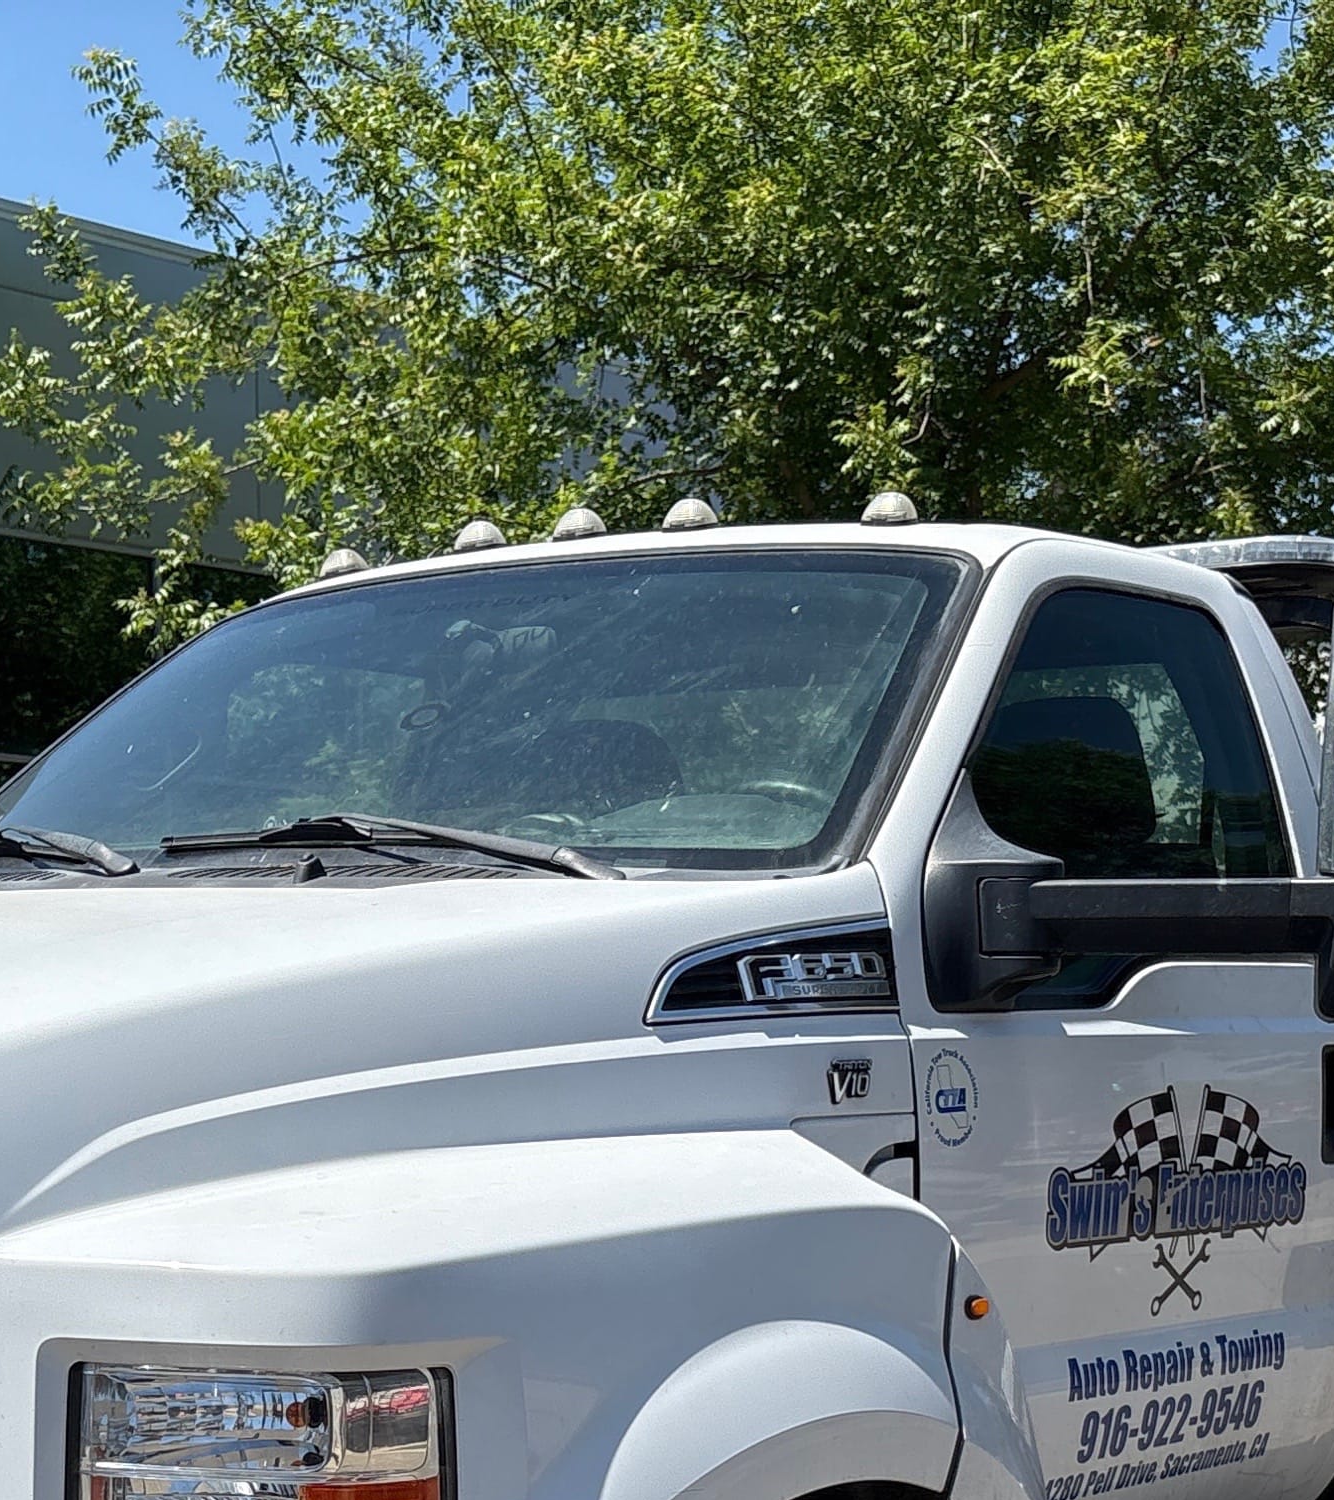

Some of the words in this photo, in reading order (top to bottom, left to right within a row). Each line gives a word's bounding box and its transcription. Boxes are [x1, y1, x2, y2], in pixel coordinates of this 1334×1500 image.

[828, 1070, 870, 1103] V10
[924, 1065, 935, 1115] California
[931, 1052, 942, 1065] Tow
[942, 1048, 959, 1059] Truck
[1047, 1166, 1154, 1251] Swim's
[1155, 1158, 1307, 1240] Enterprises
[1067, 1357, 1120, 1402] Auto
[1123, 1341, 1195, 1393] Repair
[1200, 1342, 1214, 1377] &
[1215, 1330, 1286, 1376] Towing
[1077, 1380, 1265, 1464] 916-922-9546
[1082, 1465, 1117, 1499] Pell
[1115, 1459, 1158, 1490] Drive,
[1160, 1441, 1247, 1479] Sacramento,
[1249, 1432, 1271, 1460] CA
